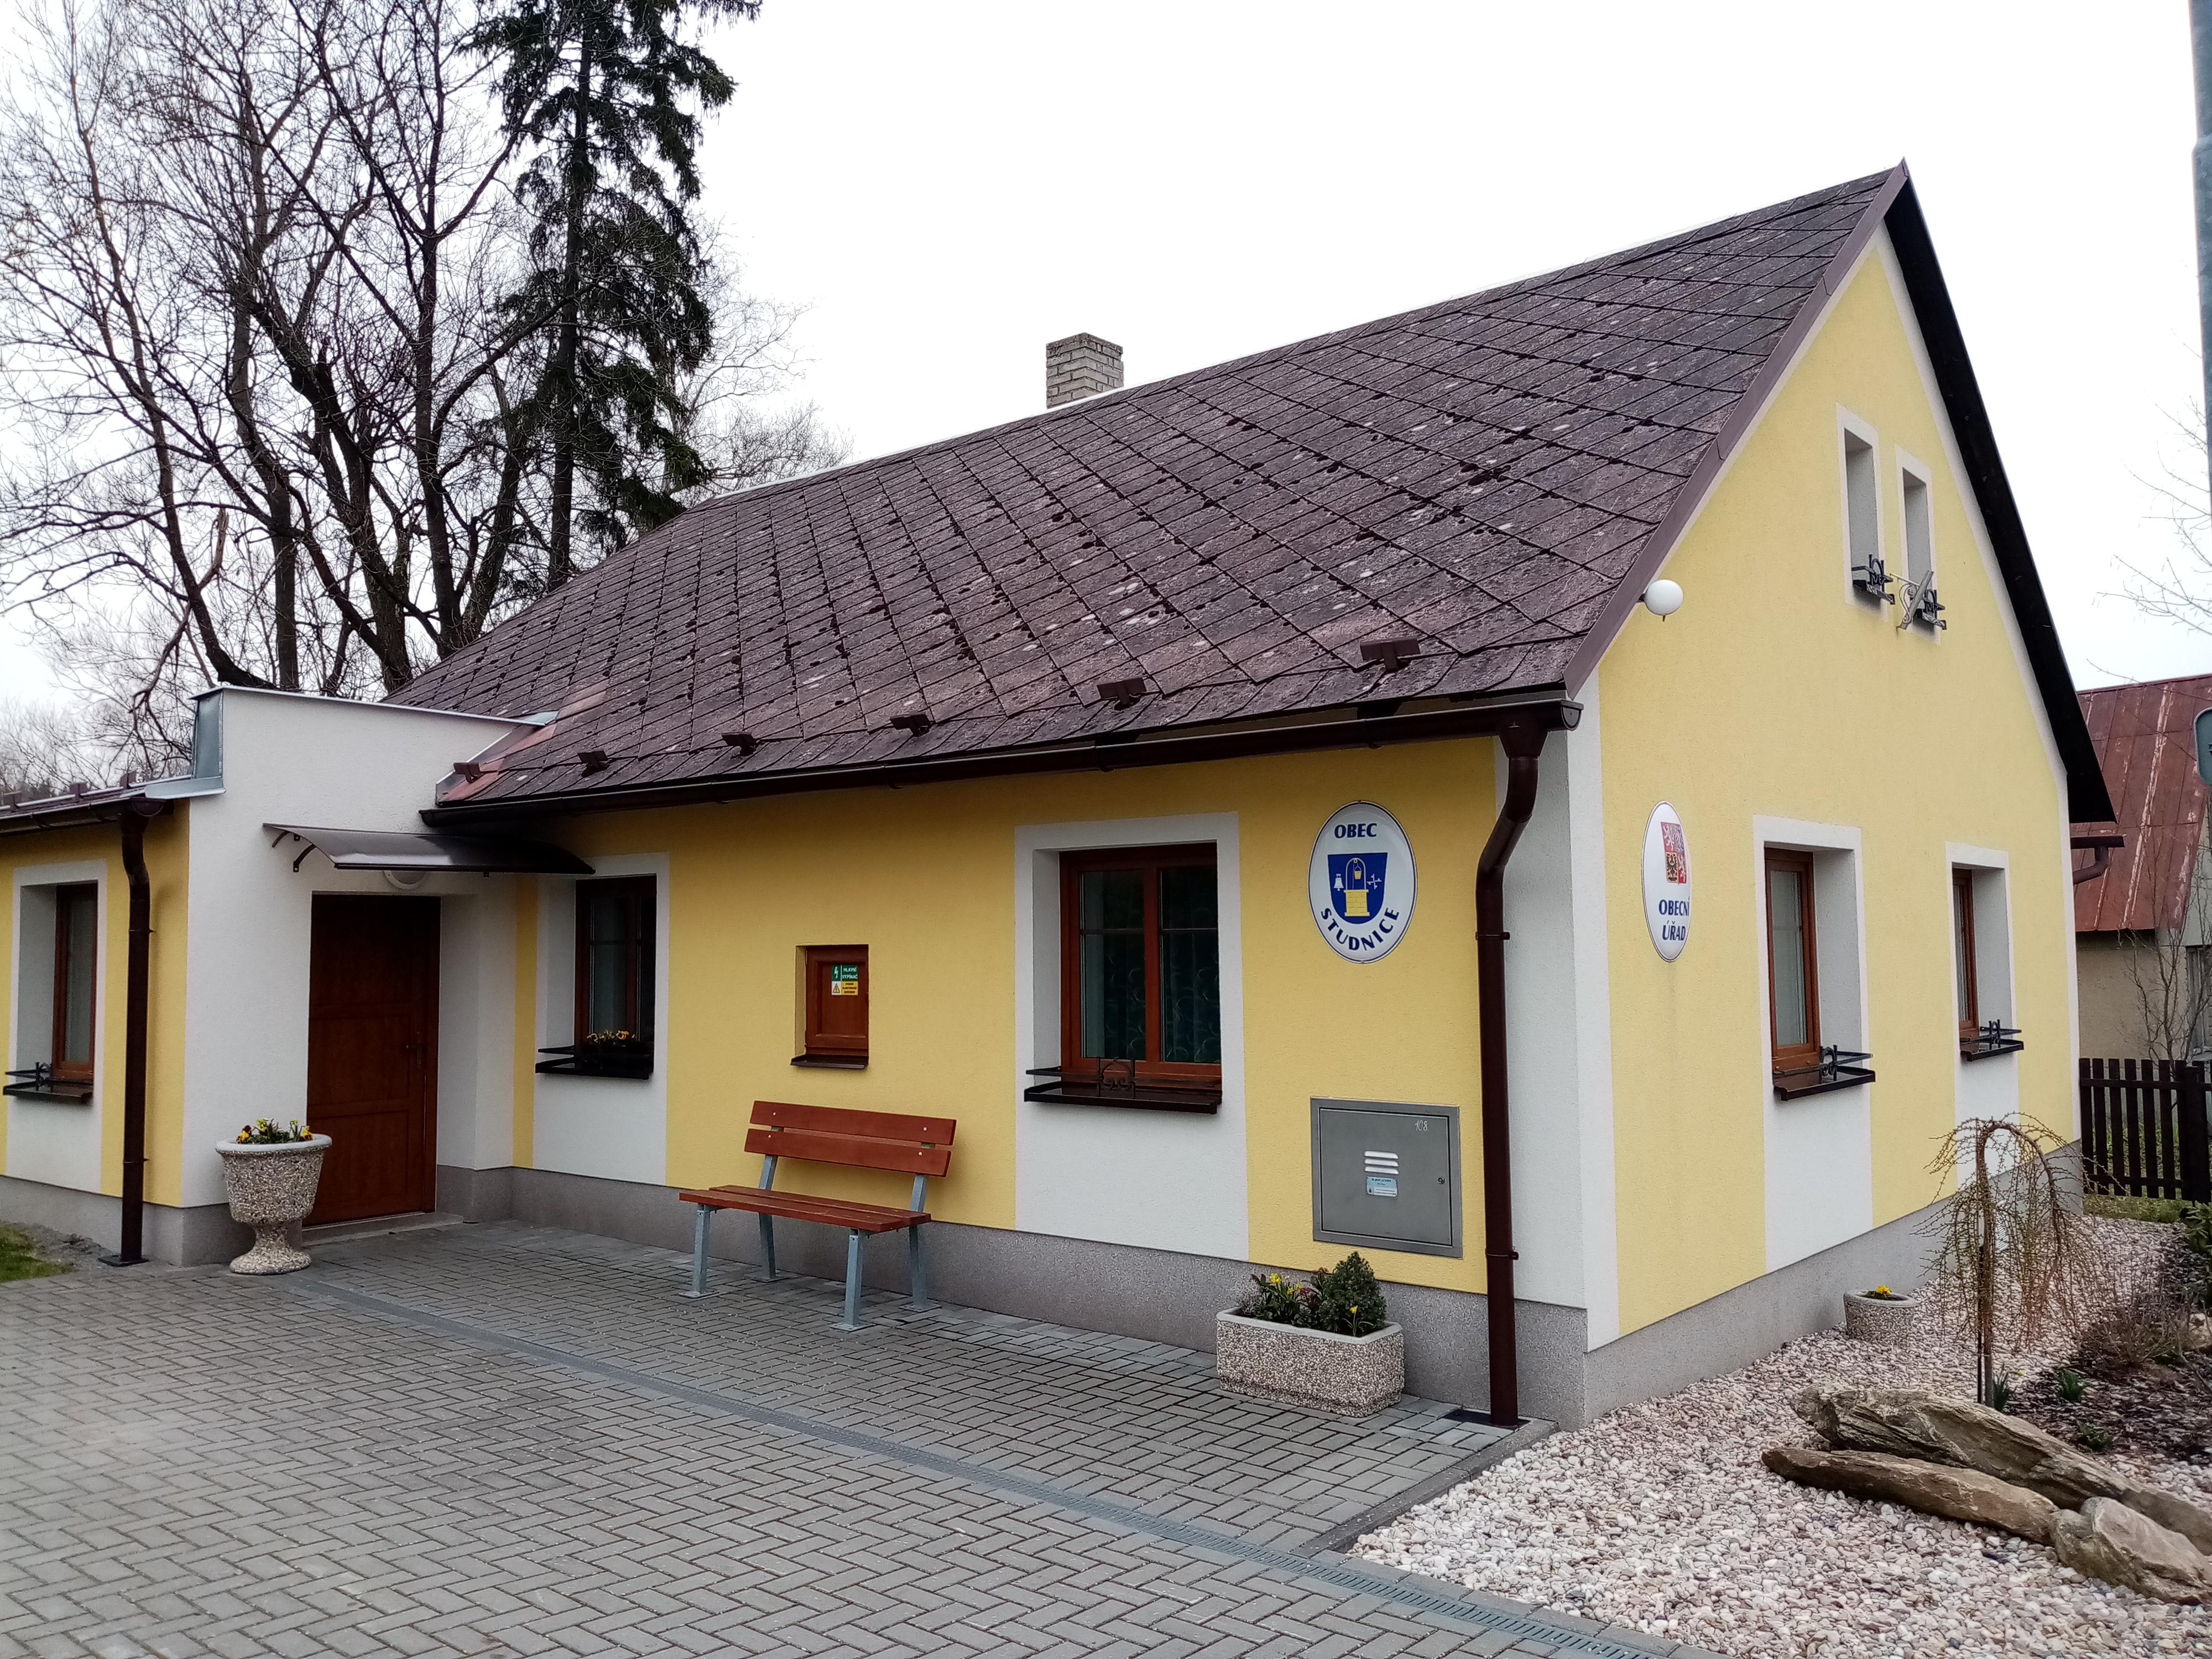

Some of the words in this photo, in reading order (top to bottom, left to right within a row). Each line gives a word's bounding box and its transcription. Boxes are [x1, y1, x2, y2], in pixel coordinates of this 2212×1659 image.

[1334, 822, 1378, 839] OBEC
[1659, 896, 1690, 916] OBECNÍ
[1321, 907, 1400, 951] STUDNICE
[1662, 920, 1686, 941] ÚŘAD
